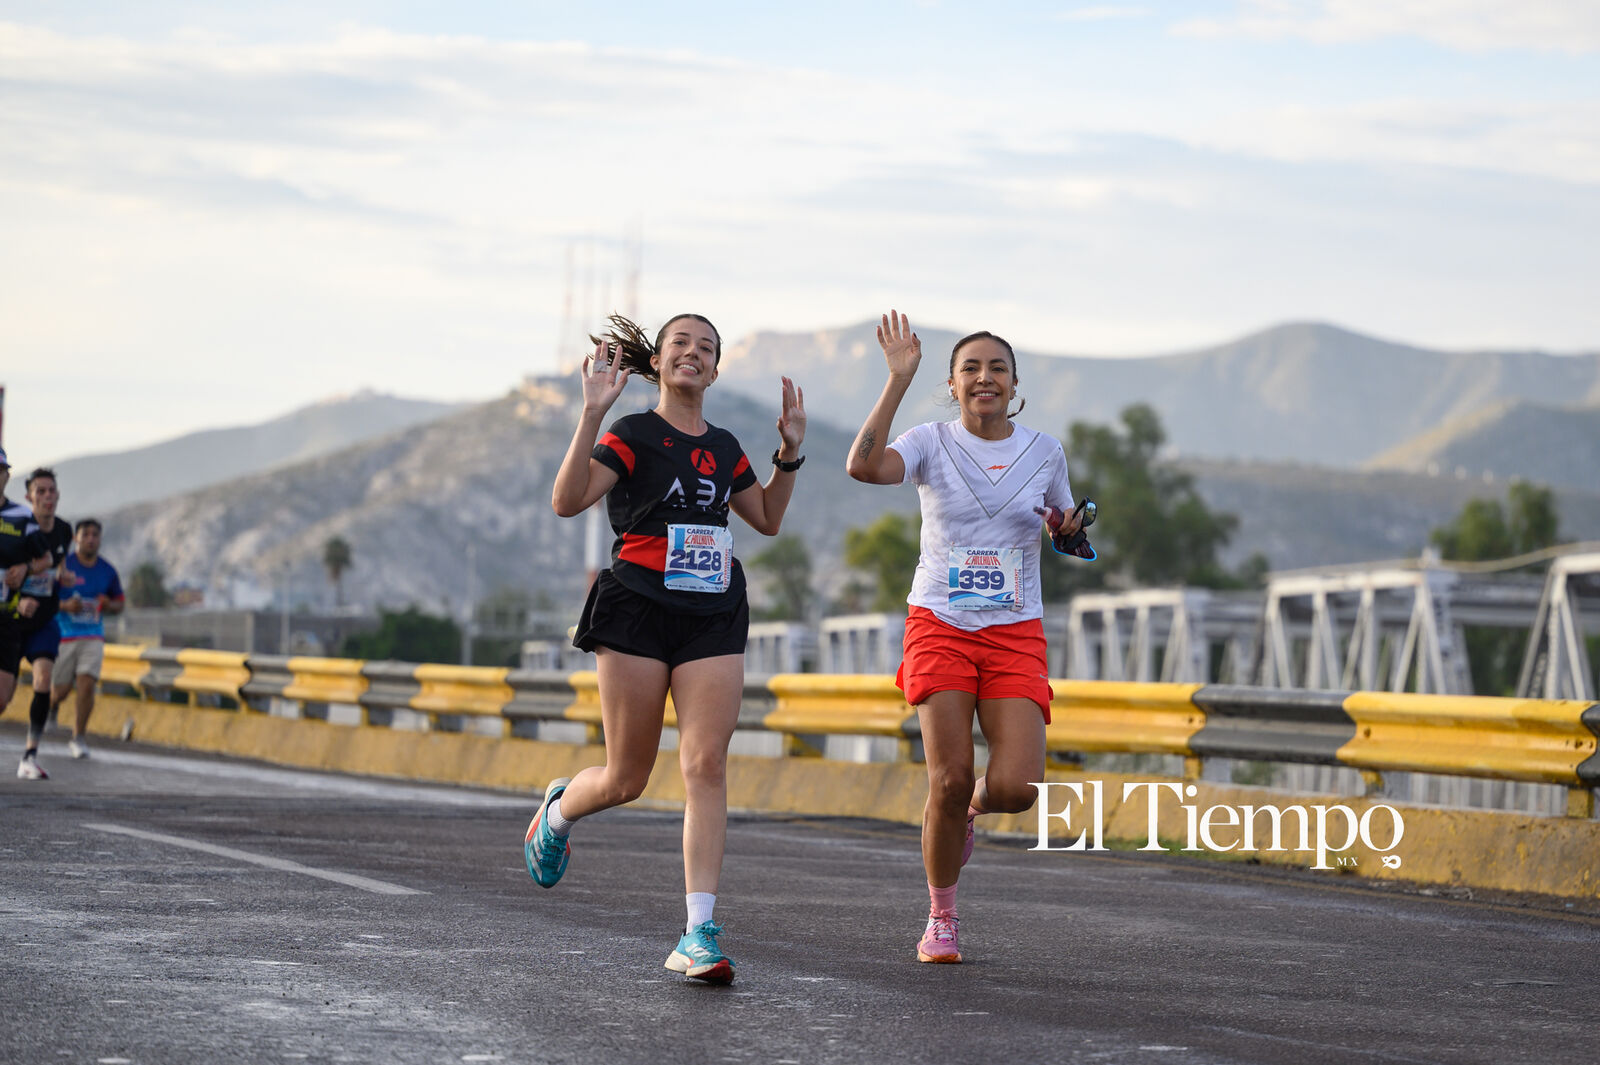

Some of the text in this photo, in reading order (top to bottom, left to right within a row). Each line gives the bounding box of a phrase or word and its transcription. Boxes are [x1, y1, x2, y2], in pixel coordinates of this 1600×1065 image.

[686, 528, 714, 536] CARRERA
[669, 549, 722, 571] 2128
[959, 569, 1005, 590] 339
